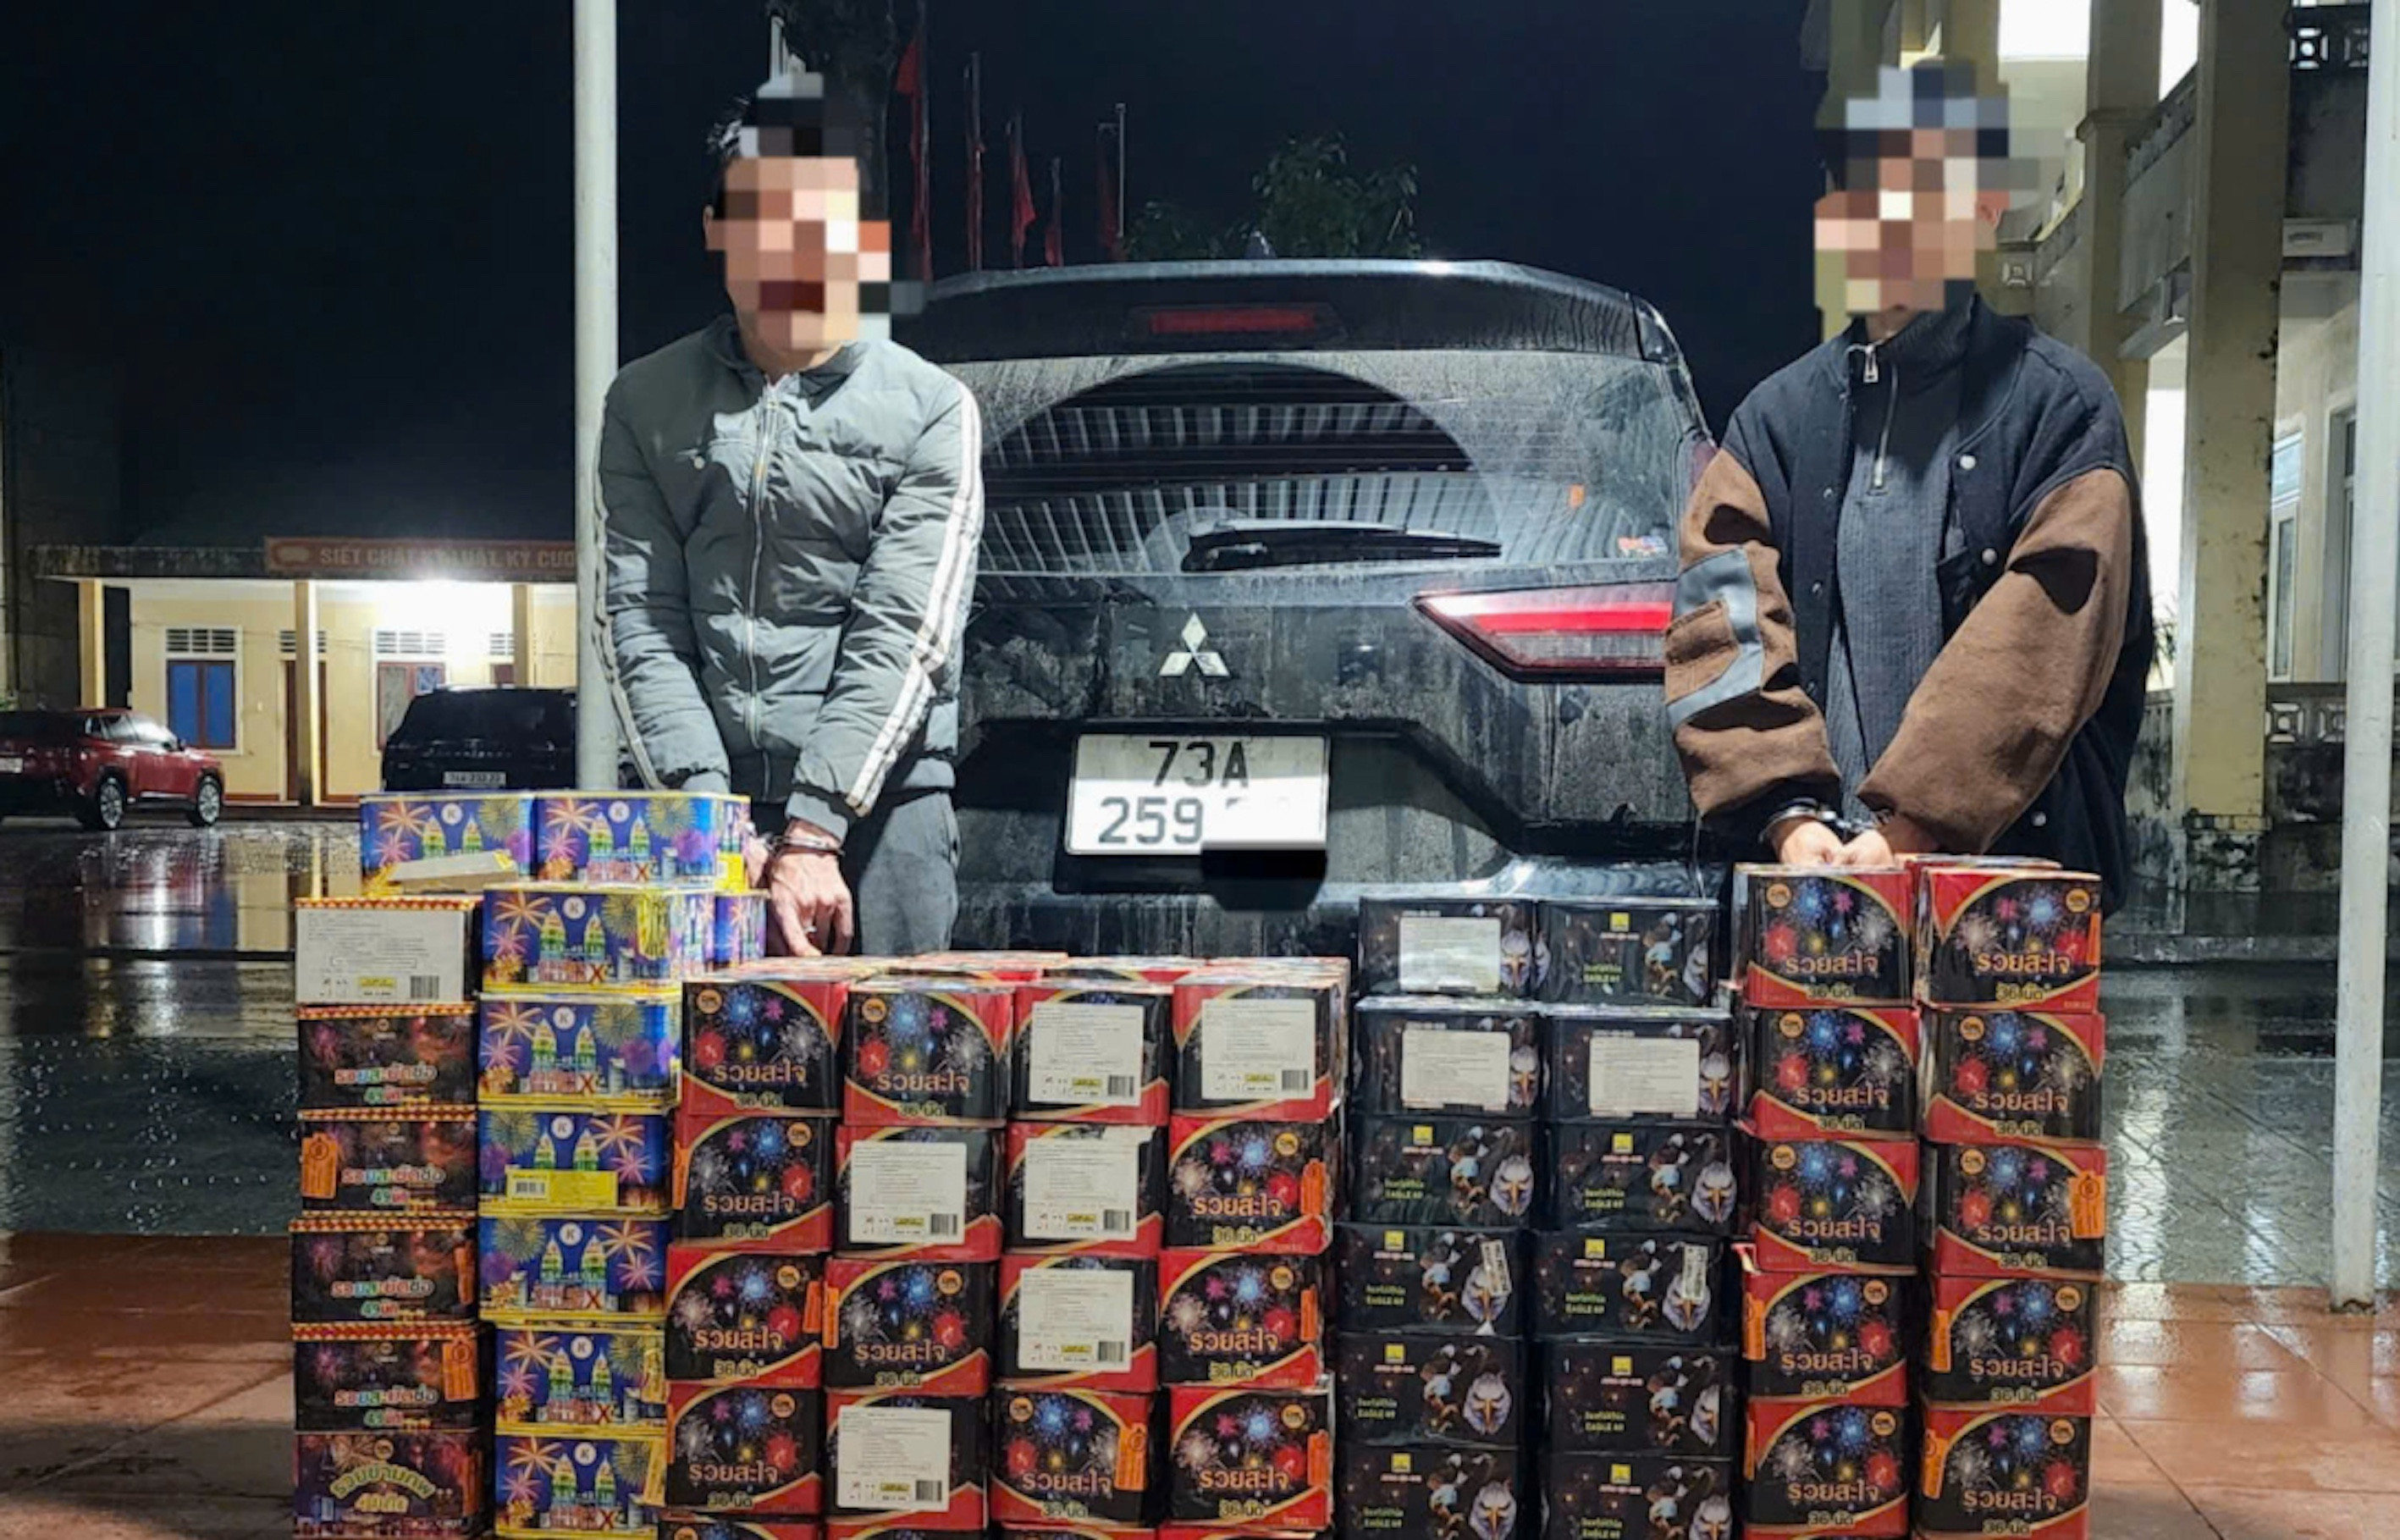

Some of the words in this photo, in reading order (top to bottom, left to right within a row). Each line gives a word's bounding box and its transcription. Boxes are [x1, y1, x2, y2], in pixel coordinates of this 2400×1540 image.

[1149, 741, 1249, 788] 73A
[1786, 951, 1879, 974] รวยสะใจ
[1977, 952, 2071, 974] รวยสะใจ
[714, 1058, 807, 1084] รวยสะใจ
[878, 1070, 970, 1093] รวยสะใจ
[1797, 1082, 1888, 1105] รวยสะใจ
[1976, 1089, 2067, 1111] รวยสะใจ
[704, 1191, 795, 1213] รวยสะใจ
[1194, 1193, 1283, 1217] รวยสะใจ
[1789, 1217, 1880, 1241] รวยสะใจ
[1978, 1222, 2070, 1243] รวยสะใจ
[695, 1328, 782, 1350] รวยสะใจ
[1190, 1329, 1279, 1352] รวยสะใจ
[856, 1342, 946, 1361] รวยสะใจ
[1782, 1347, 1874, 1372] รวยสะใจ
[1970, 1355, 2064, 1377] รวยสะใจ
[689, 1462, 778, 1483] รวยสะใจ
[1023, 1469, 1112, 1493] รวยสะใจ
[1200, 1469, 1289, 1490] รวยสะใจ
[1789, 1481, 1879, 1502] รวยสะใจ
[1964, 1489, 2057, 1510] รวยสะใจ
